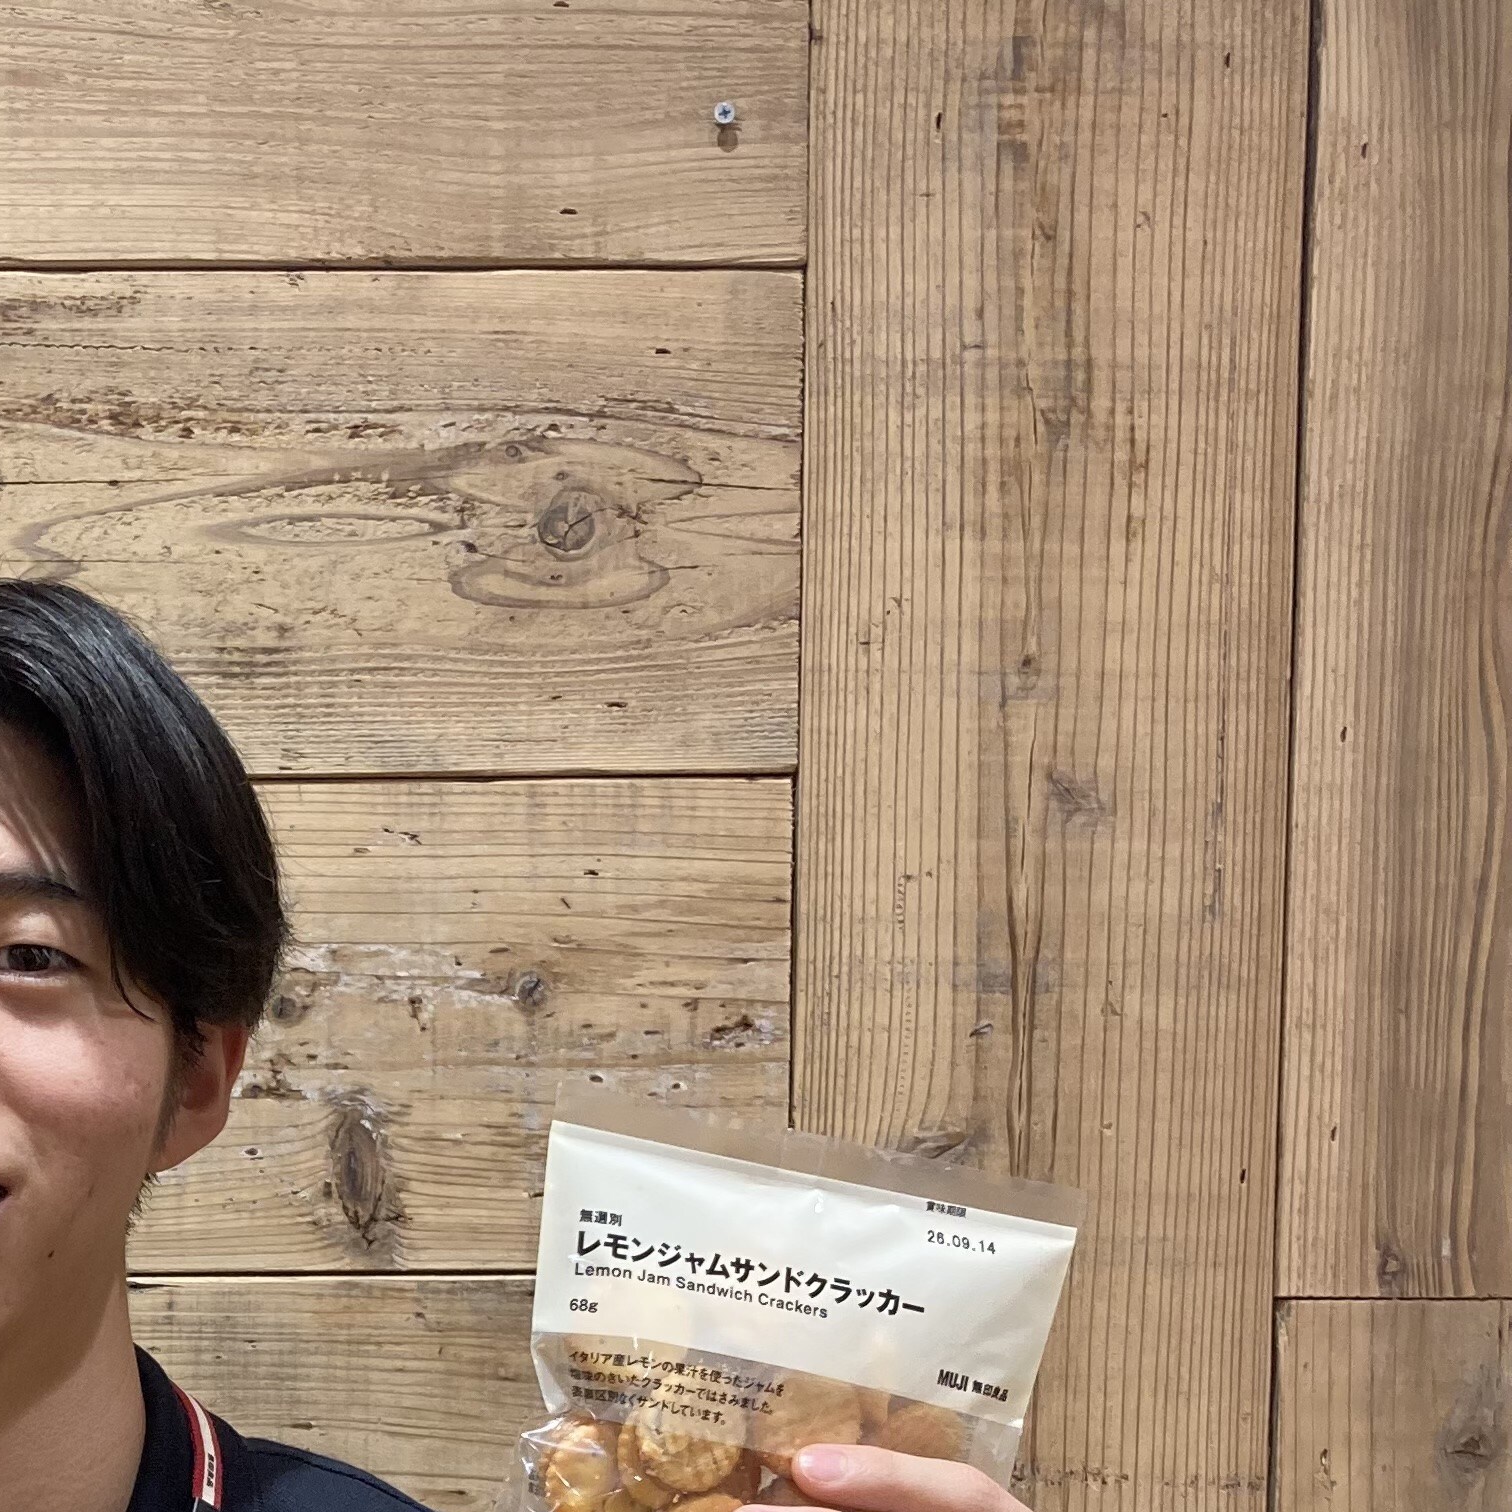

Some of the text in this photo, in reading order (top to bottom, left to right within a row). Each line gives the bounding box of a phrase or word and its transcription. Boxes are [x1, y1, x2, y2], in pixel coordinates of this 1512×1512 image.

[579, 1209, 623, 1227] 無選別
[927, 1230, 996, 1255] 26.09.14
[576, 1230, 925, 1316] レモンジャムサンドクラッカー
[574, 1263, 828, 1319] Lemon Jam Sandwich Crackers
[569, 1298, 599, 1314] 68g
[937, 1368, 1009, 1402] MUJI 無印良品
